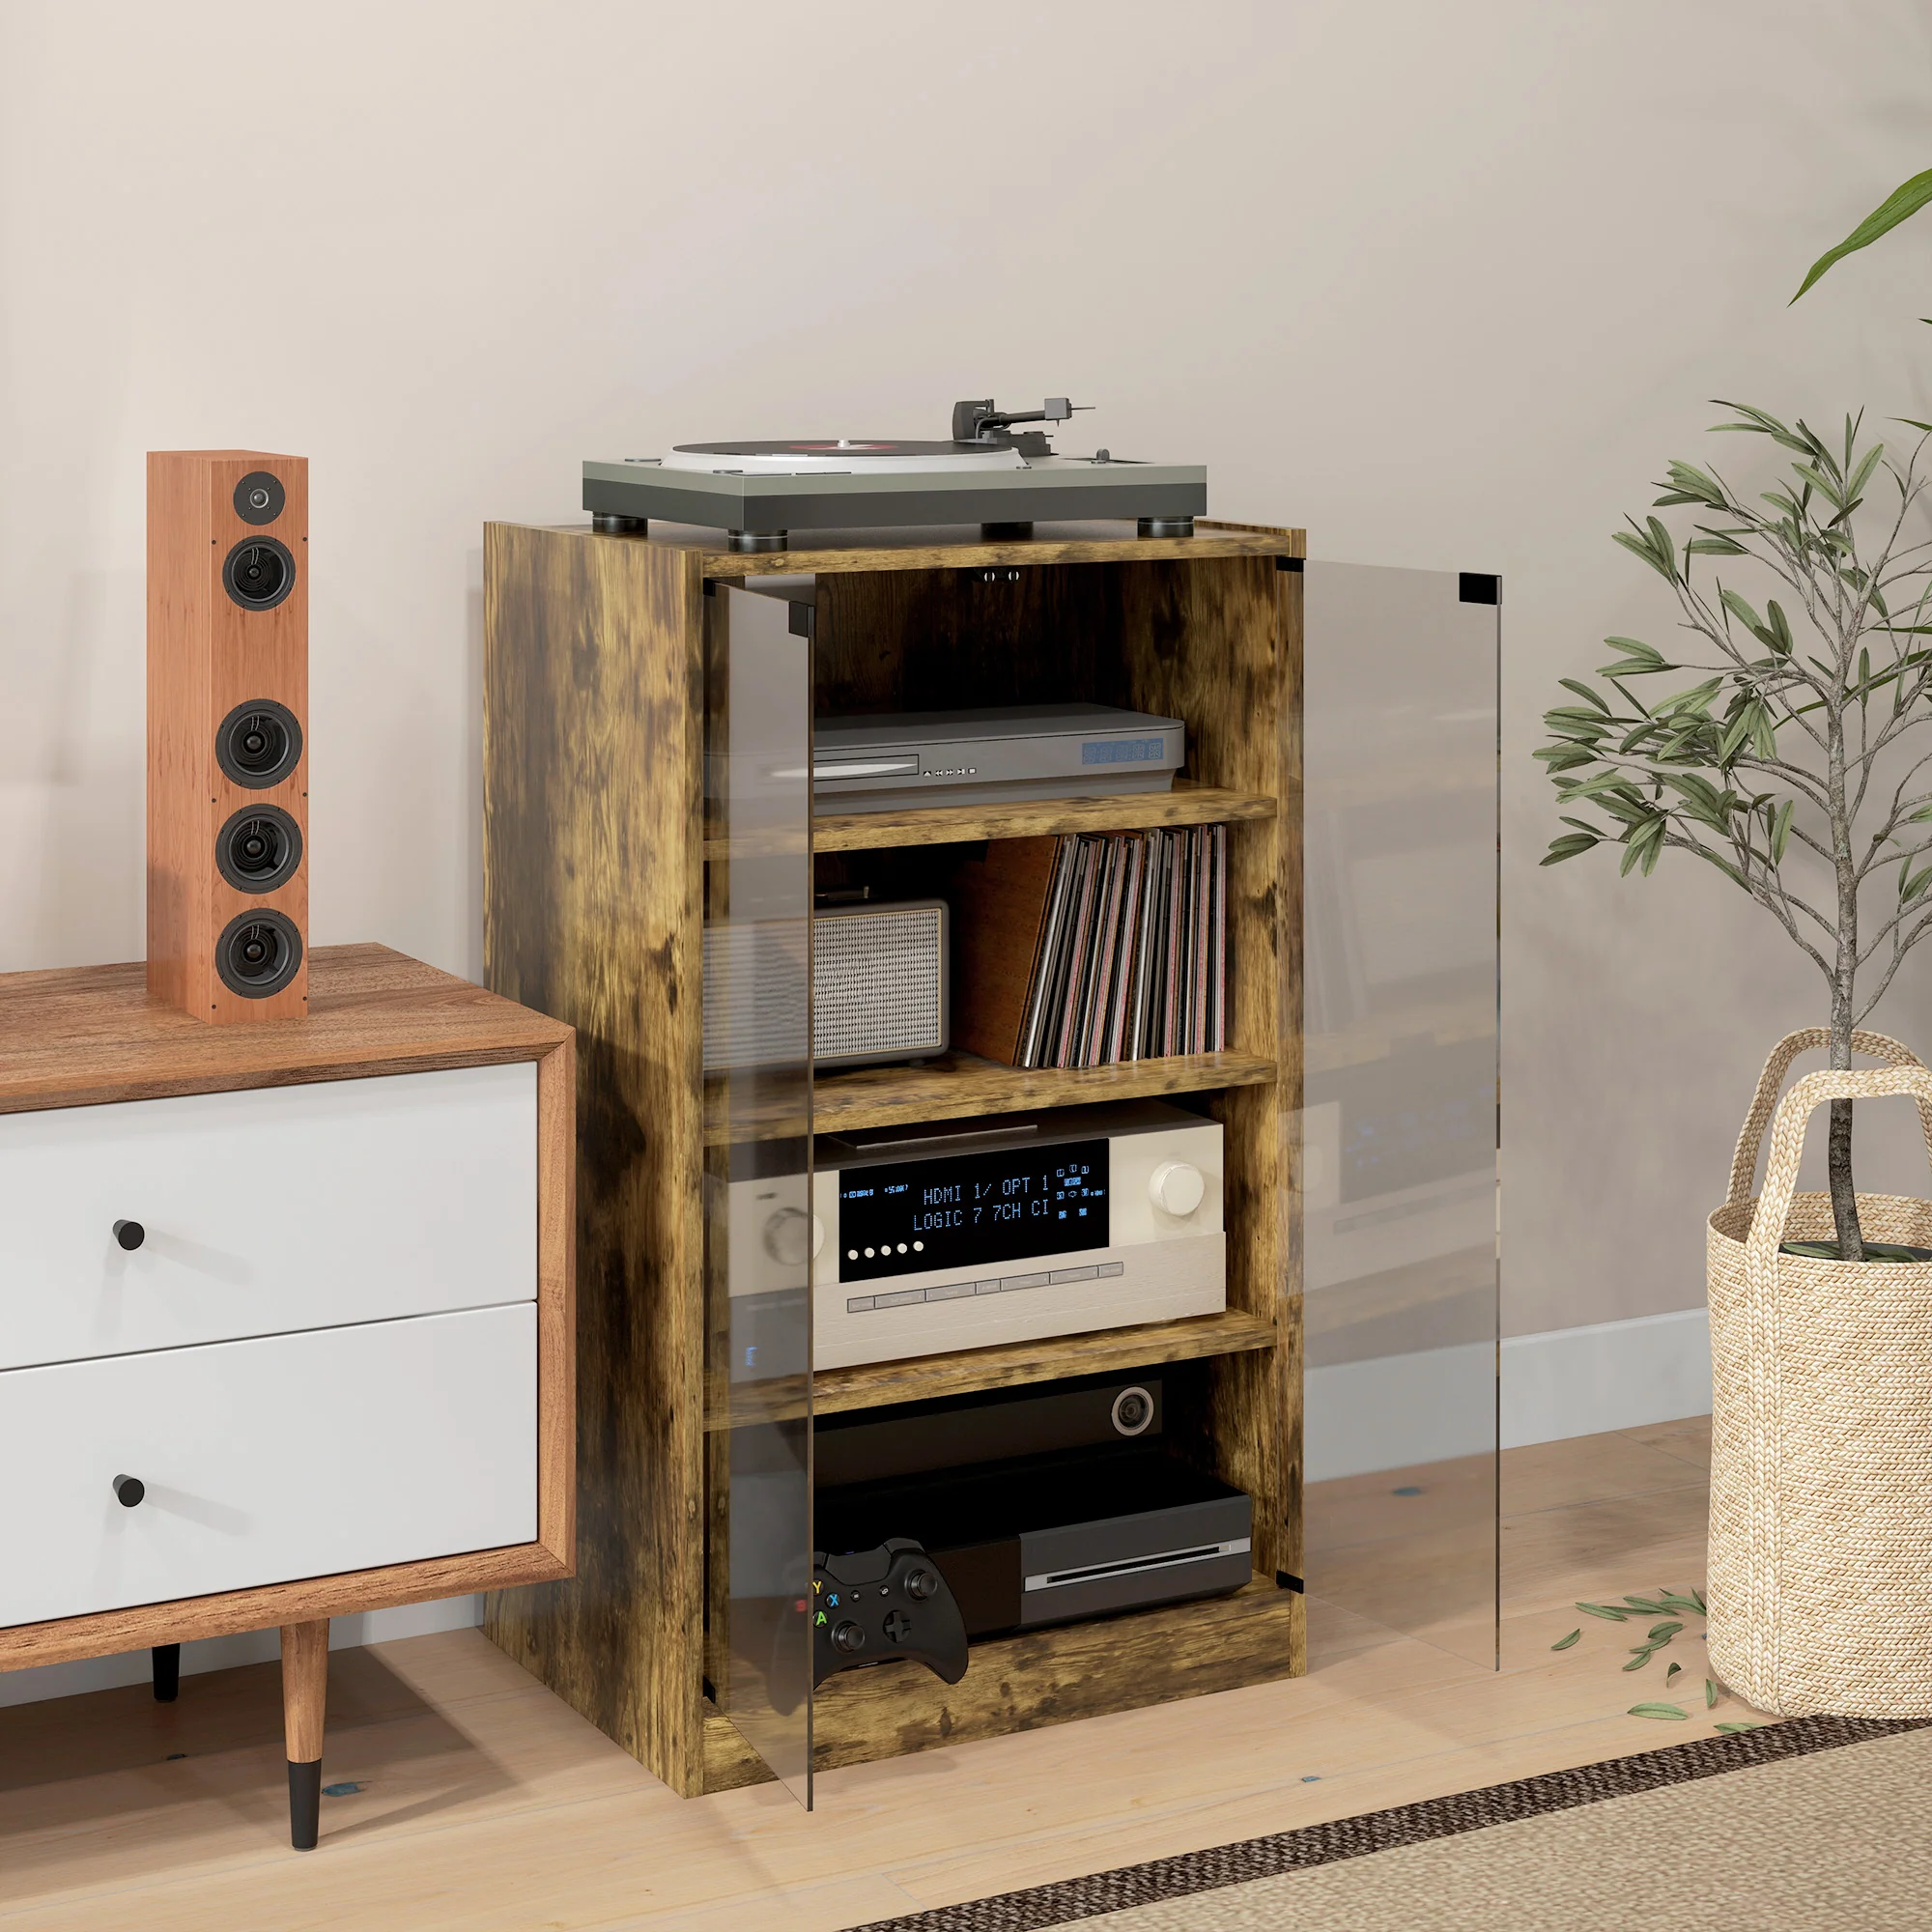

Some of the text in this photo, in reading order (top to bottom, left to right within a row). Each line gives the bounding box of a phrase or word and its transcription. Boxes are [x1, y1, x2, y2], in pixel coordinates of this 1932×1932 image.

[923, 1185, 961, 1206] HDMI
[974, 1182, 992, 1199] 1/
[1002, 1177, 1031, 1196] OPT
[1042, 1175, 1049, 1191] 1
[914, 1209, 963, 1231] LOGIC
[974, 1208, 982, 1224] 7
[993, 1202, 1021, 1221] 7CH
[1031, 1199, 1049, 1216] CI
[812, 1581, 822, 1594] Y
[829, 1594, 839, 1606] X
[816, 1611, 827, 1625] A
